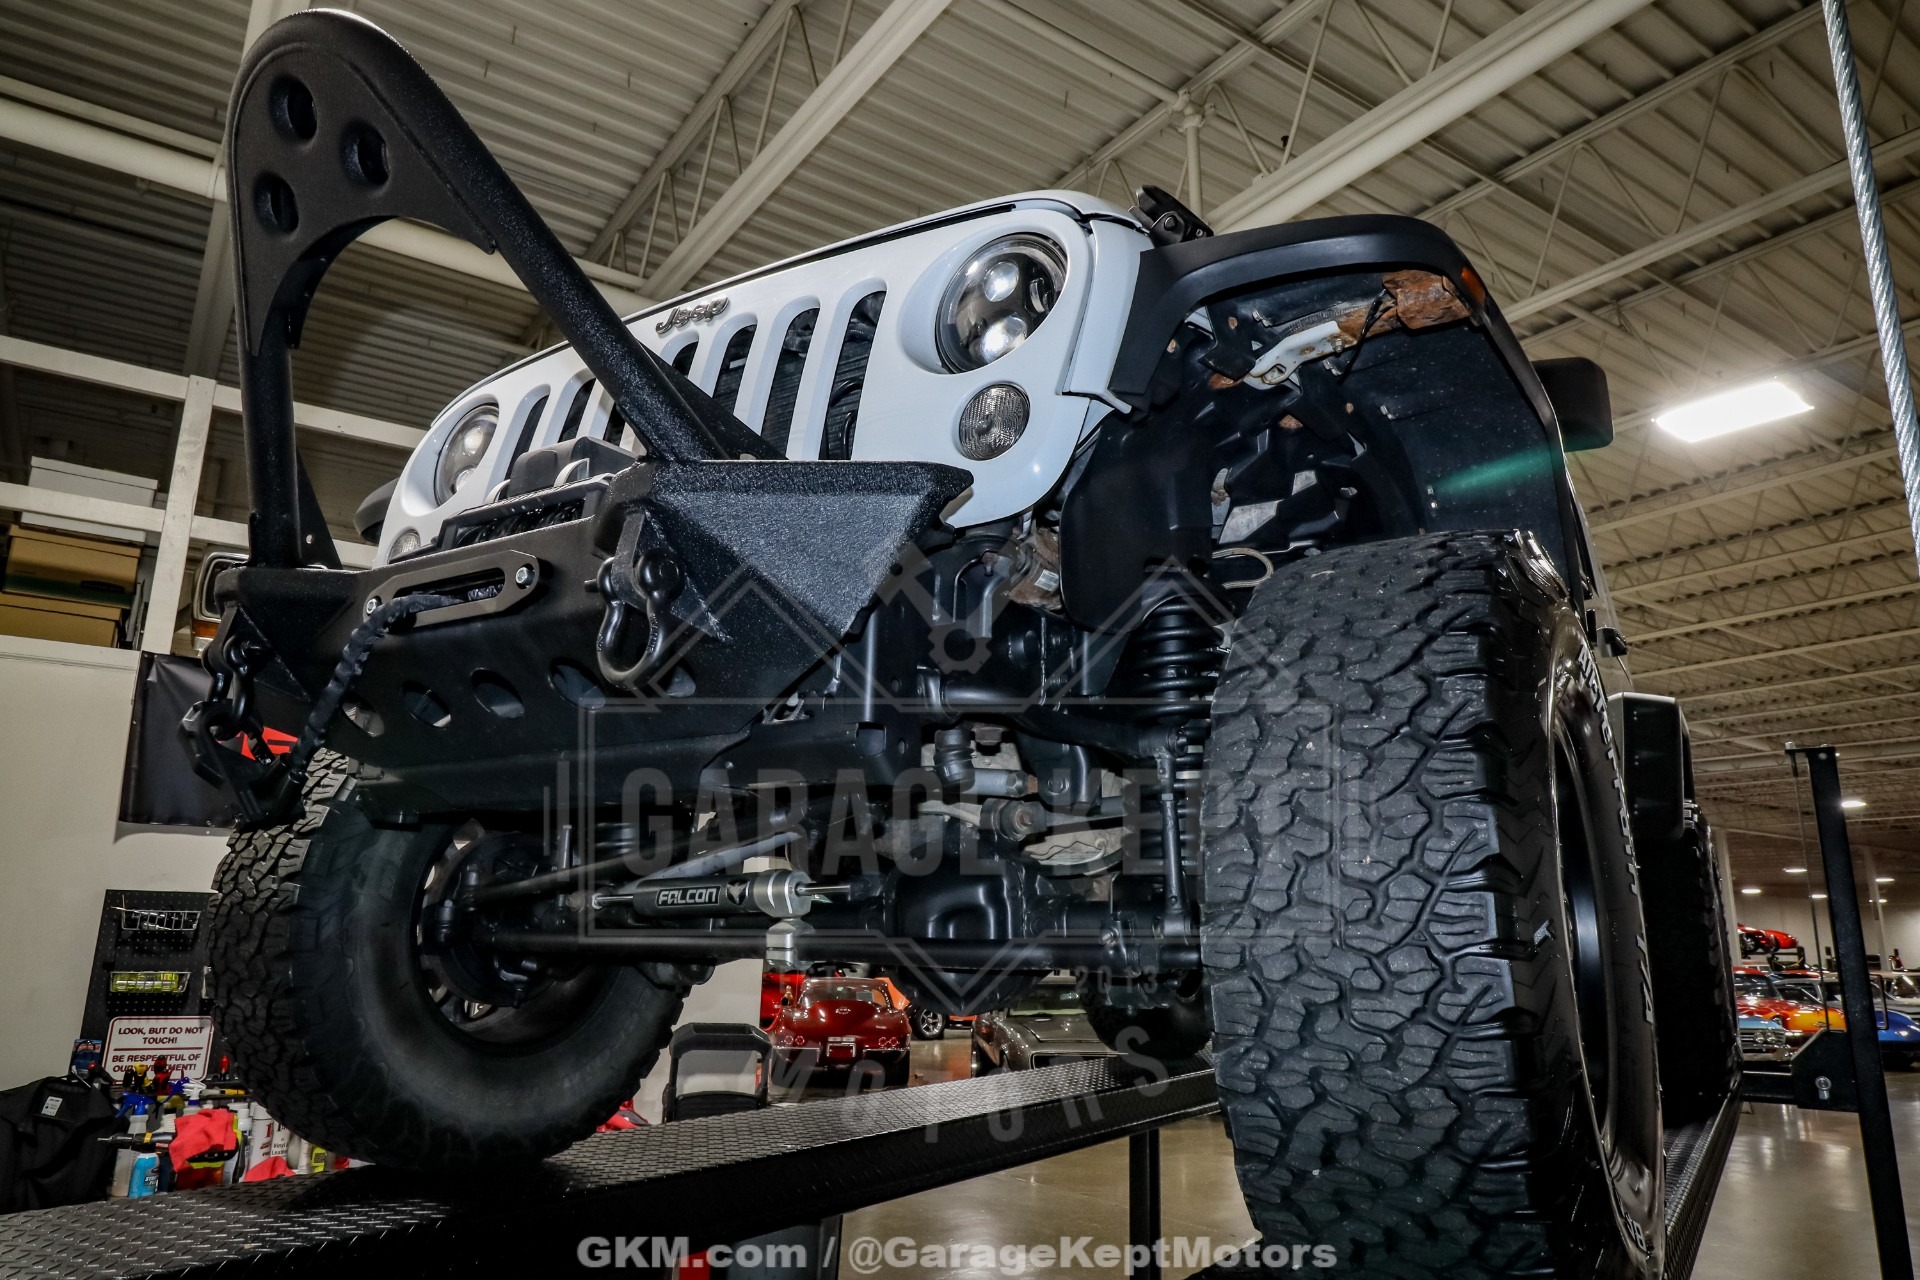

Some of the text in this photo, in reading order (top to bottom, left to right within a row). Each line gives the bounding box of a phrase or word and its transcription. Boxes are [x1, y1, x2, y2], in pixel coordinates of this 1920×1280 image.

[654, 296, 730, 334] Jeep
[658, 887, 718, 904] FALCON
[118, 1026, 205, 1036] LOOK, BUT DO NOT
[142, 1037, 178, 1045] TOUCH!
[112, 1053, 202, 1063] BE RESPETFUL OF
